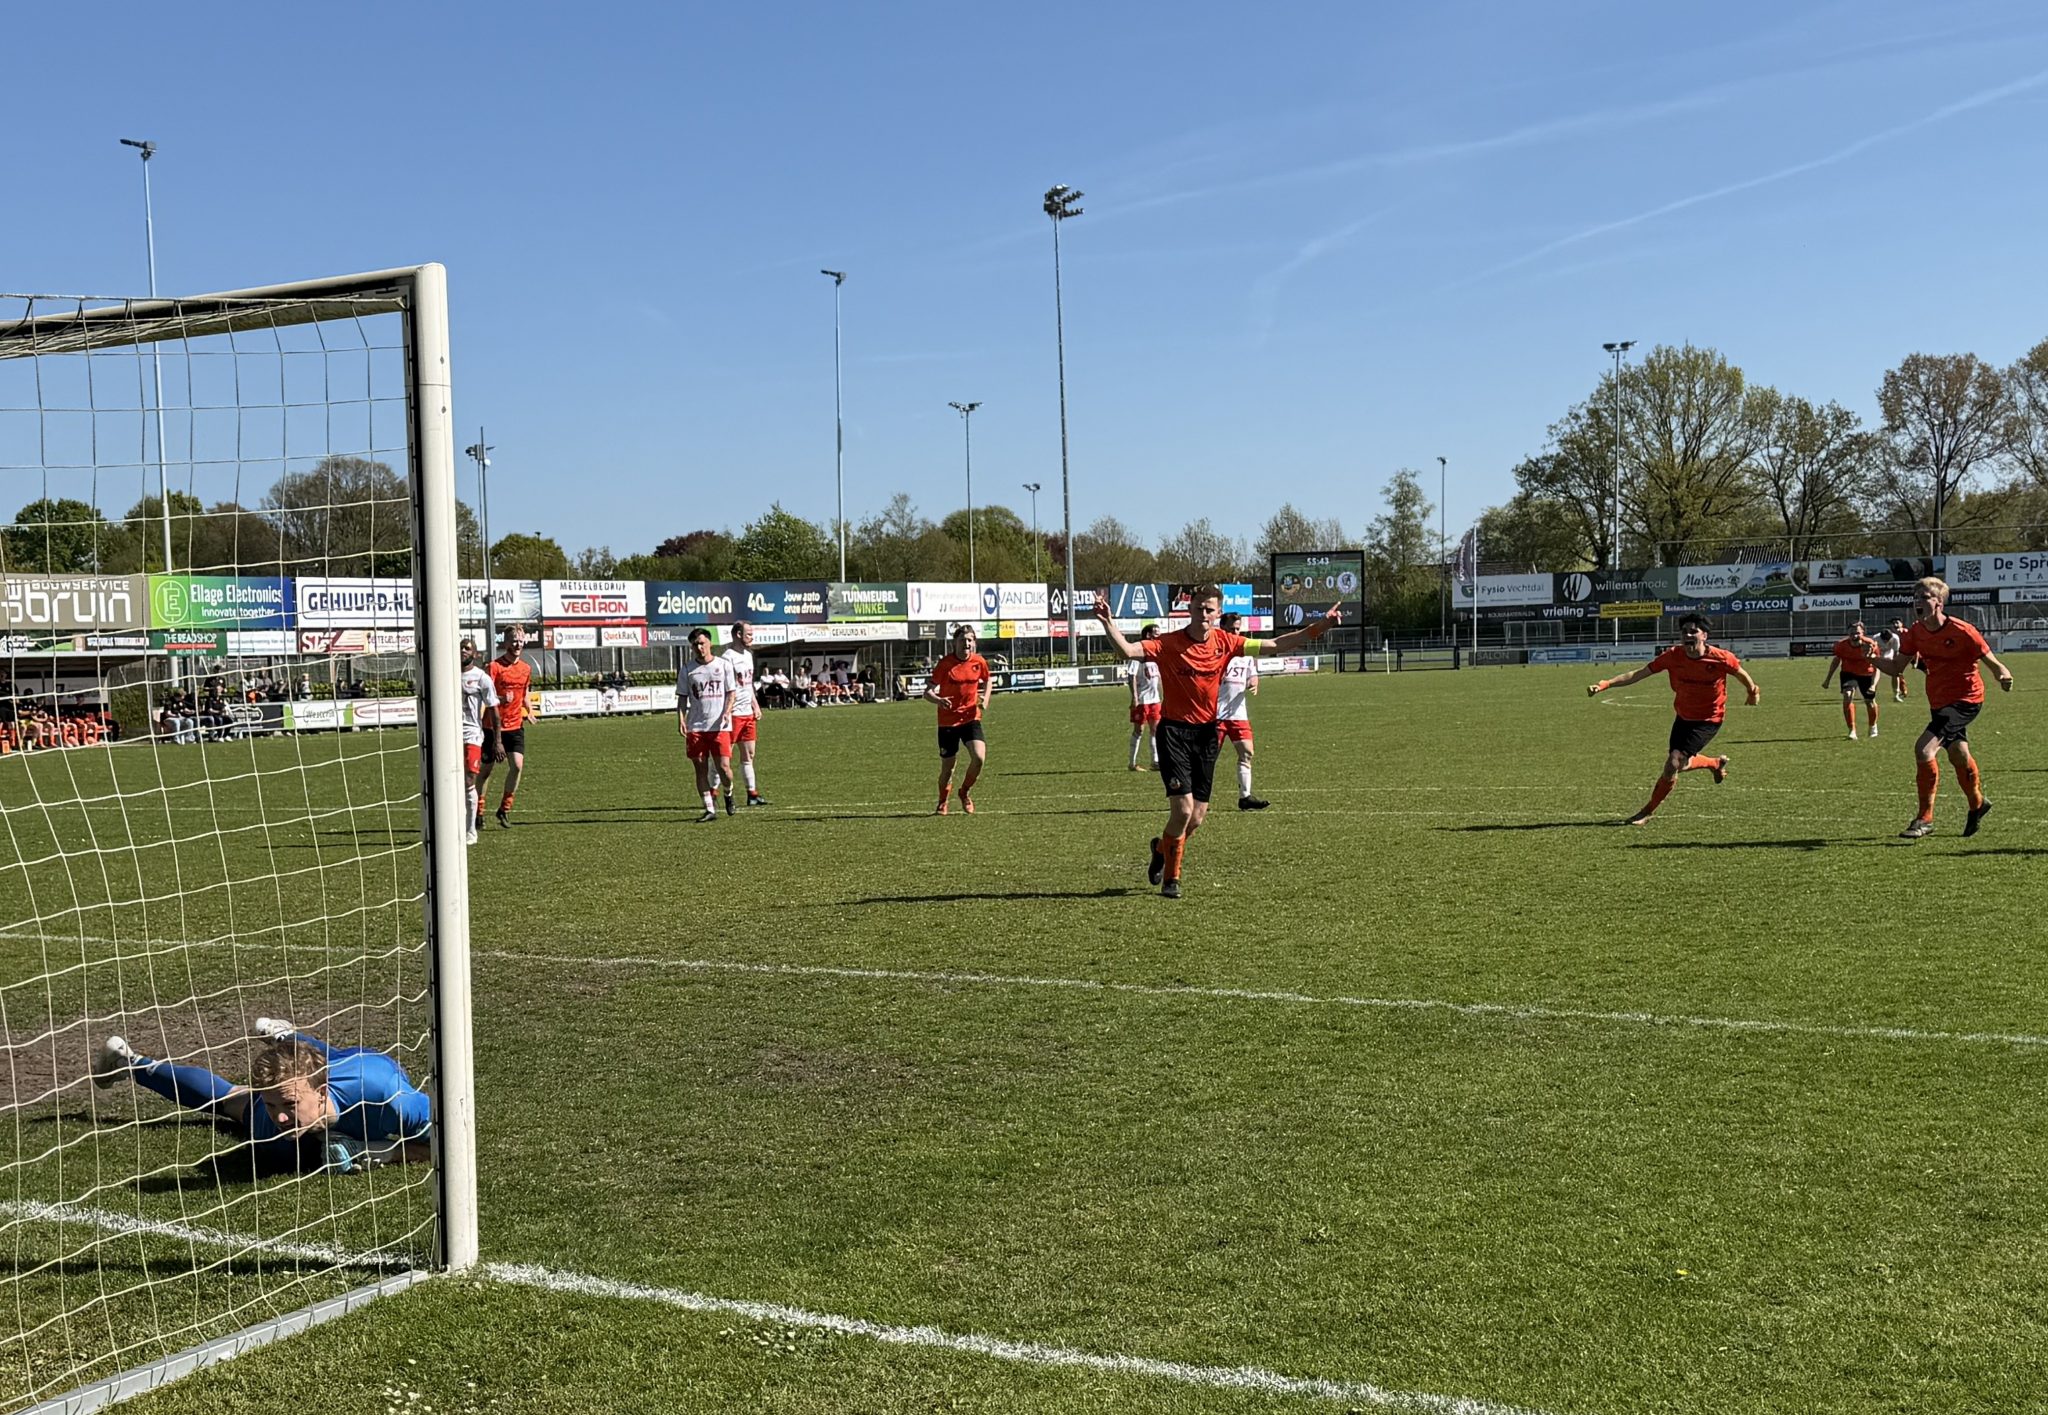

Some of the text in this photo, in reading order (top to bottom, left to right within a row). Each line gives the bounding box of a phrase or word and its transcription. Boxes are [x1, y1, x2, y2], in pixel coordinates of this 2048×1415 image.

[1994, 557, 2014, 570] De
[560, 582, 626, 591] METSELBEDRIJF
[1304, 576, 1313, 589] 0
[1325, 575, 1335, 588] 0
[1595, 579, 1668, 591] willemsmode
[190, 584, 283, 606] Ellage Electronics
[1481, 583, 1545, 595] Fysio Vechtdal
[308, 592, 413, 612] GEHUURD.NL
[657, 590, 733, 615] zieleman
[842, 590, 899, 603] TUINMEUBEL
[1811, 597, 1853, 607] Rabobank
[561, 595, 628, 613] VEGTRON
[853, 602, 888, 614] WINKEL
[1744, 599, 1789, 610] STACON
[201, 606, 275, 618] Innovate together
[1542, 605, 1585, 618] vrieling
[164, 633, 177, 643] THE
[196, 633, 217, 643] SHOP
